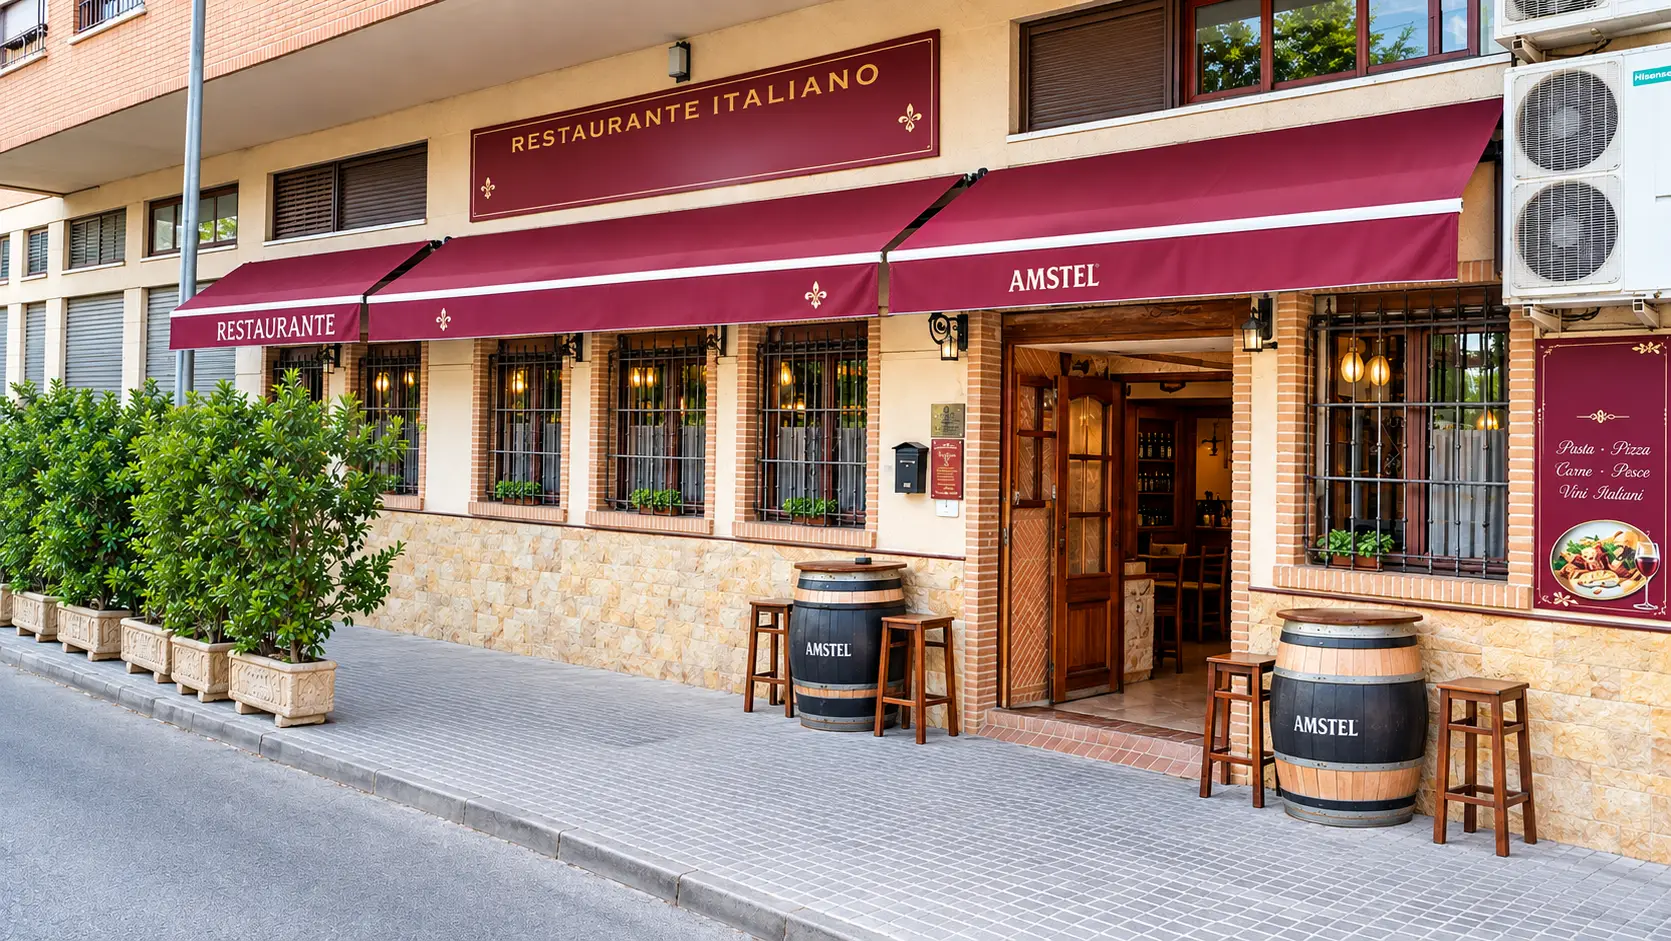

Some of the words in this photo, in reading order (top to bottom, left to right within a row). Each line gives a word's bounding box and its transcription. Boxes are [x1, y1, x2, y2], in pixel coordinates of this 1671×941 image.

[511, 100, 699, 152] RESTAURANTE
[713, 63, 879, 115] ITALIANO
[1008, 263, 1099, 292] AMSTEL
[217, 313, 335, 341] RESTAURANTE
[1556, 440, 1595, 455] Pasta
[1611, 440, 1651, 455] Pizza
[1555, 461, 1593, 477] Carne
[1611, 462, 1650, 478] Pesce
[1559, 484, 1588, 499] Vini
[1593, 485, 1645, 501] Italiani
[806, 641, 852, 657] AMSTEL
[1294, 715, 1358, 736] AMSTEL
